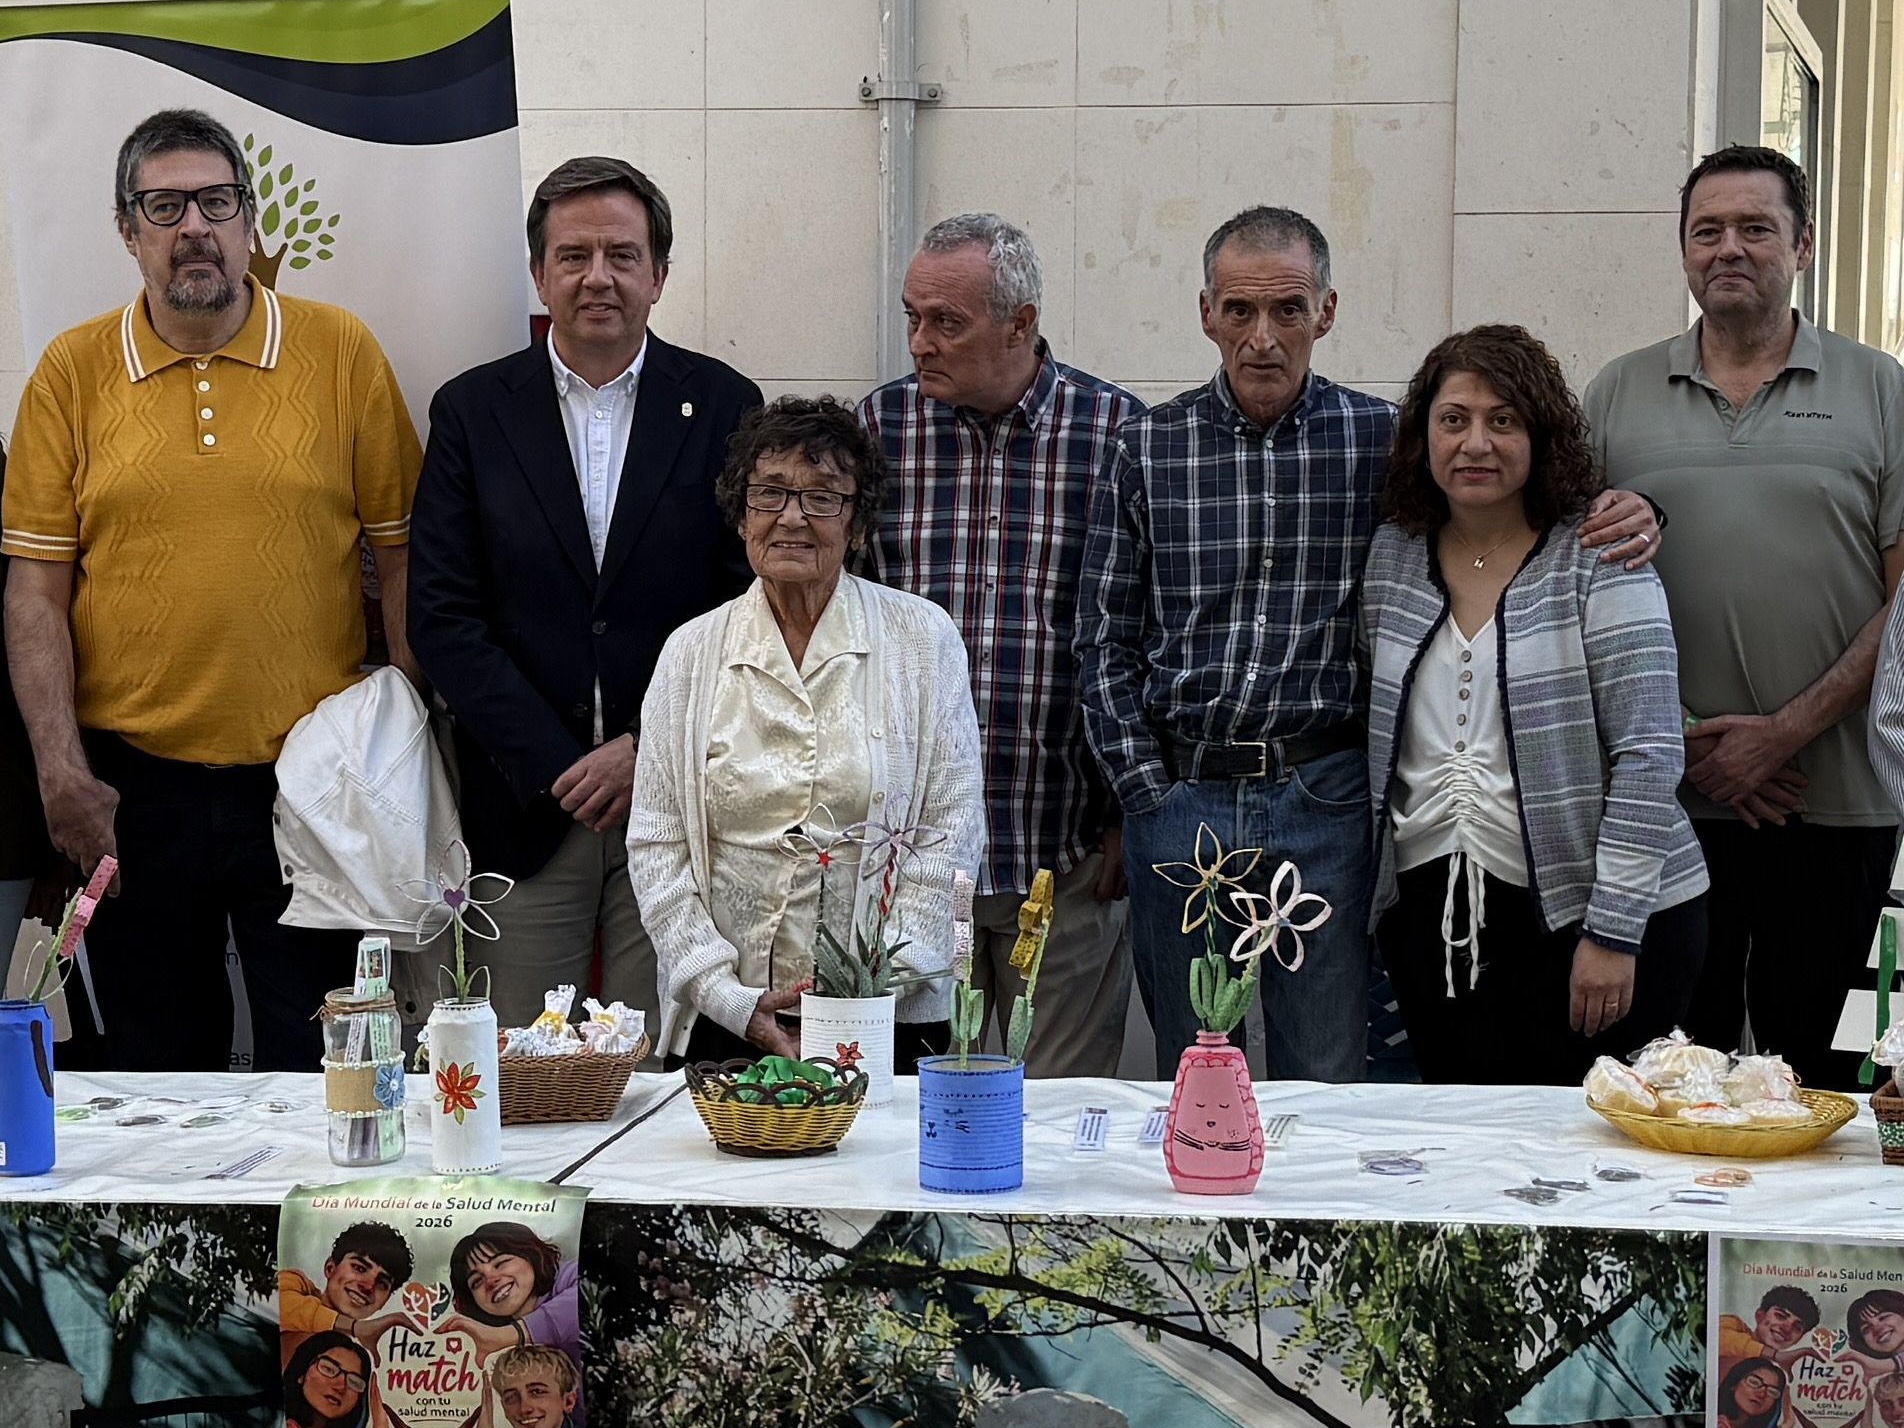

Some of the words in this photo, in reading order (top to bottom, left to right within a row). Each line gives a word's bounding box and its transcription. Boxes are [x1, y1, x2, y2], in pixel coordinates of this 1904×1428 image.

[312, 1196, 339, 1209] Día
[344, 1196, 411, 1209] Mundial
[414, 1201, 429, 1210] de
[432, 1200, 442, 1210] la
[446, 1197, 492, 1211] Salud
[497, 1199, 556, 1213] Mental
[415, 1215, 453, 1228] 2026
[1743, 1263, 1763, 1275] Día
[1766, 1265, 1814, 1278] Mundial
[1839, 1269, 1873, 1281] Salud
[1820, 1283, 1848, 1293] 2026
[389, 1327, 436, 1363] Haz
[386, 1351, 480, 1396] match
[1800, 1357, 1834, 1380] Haz
[1797, 1374, 1864, 1401] match
[416, 1397, 436, 1406] con
[439, 1397, 451, 1406] tu
[398, 1406, 427, 1417] salud
[430, 1407, 470, 1417] mental
